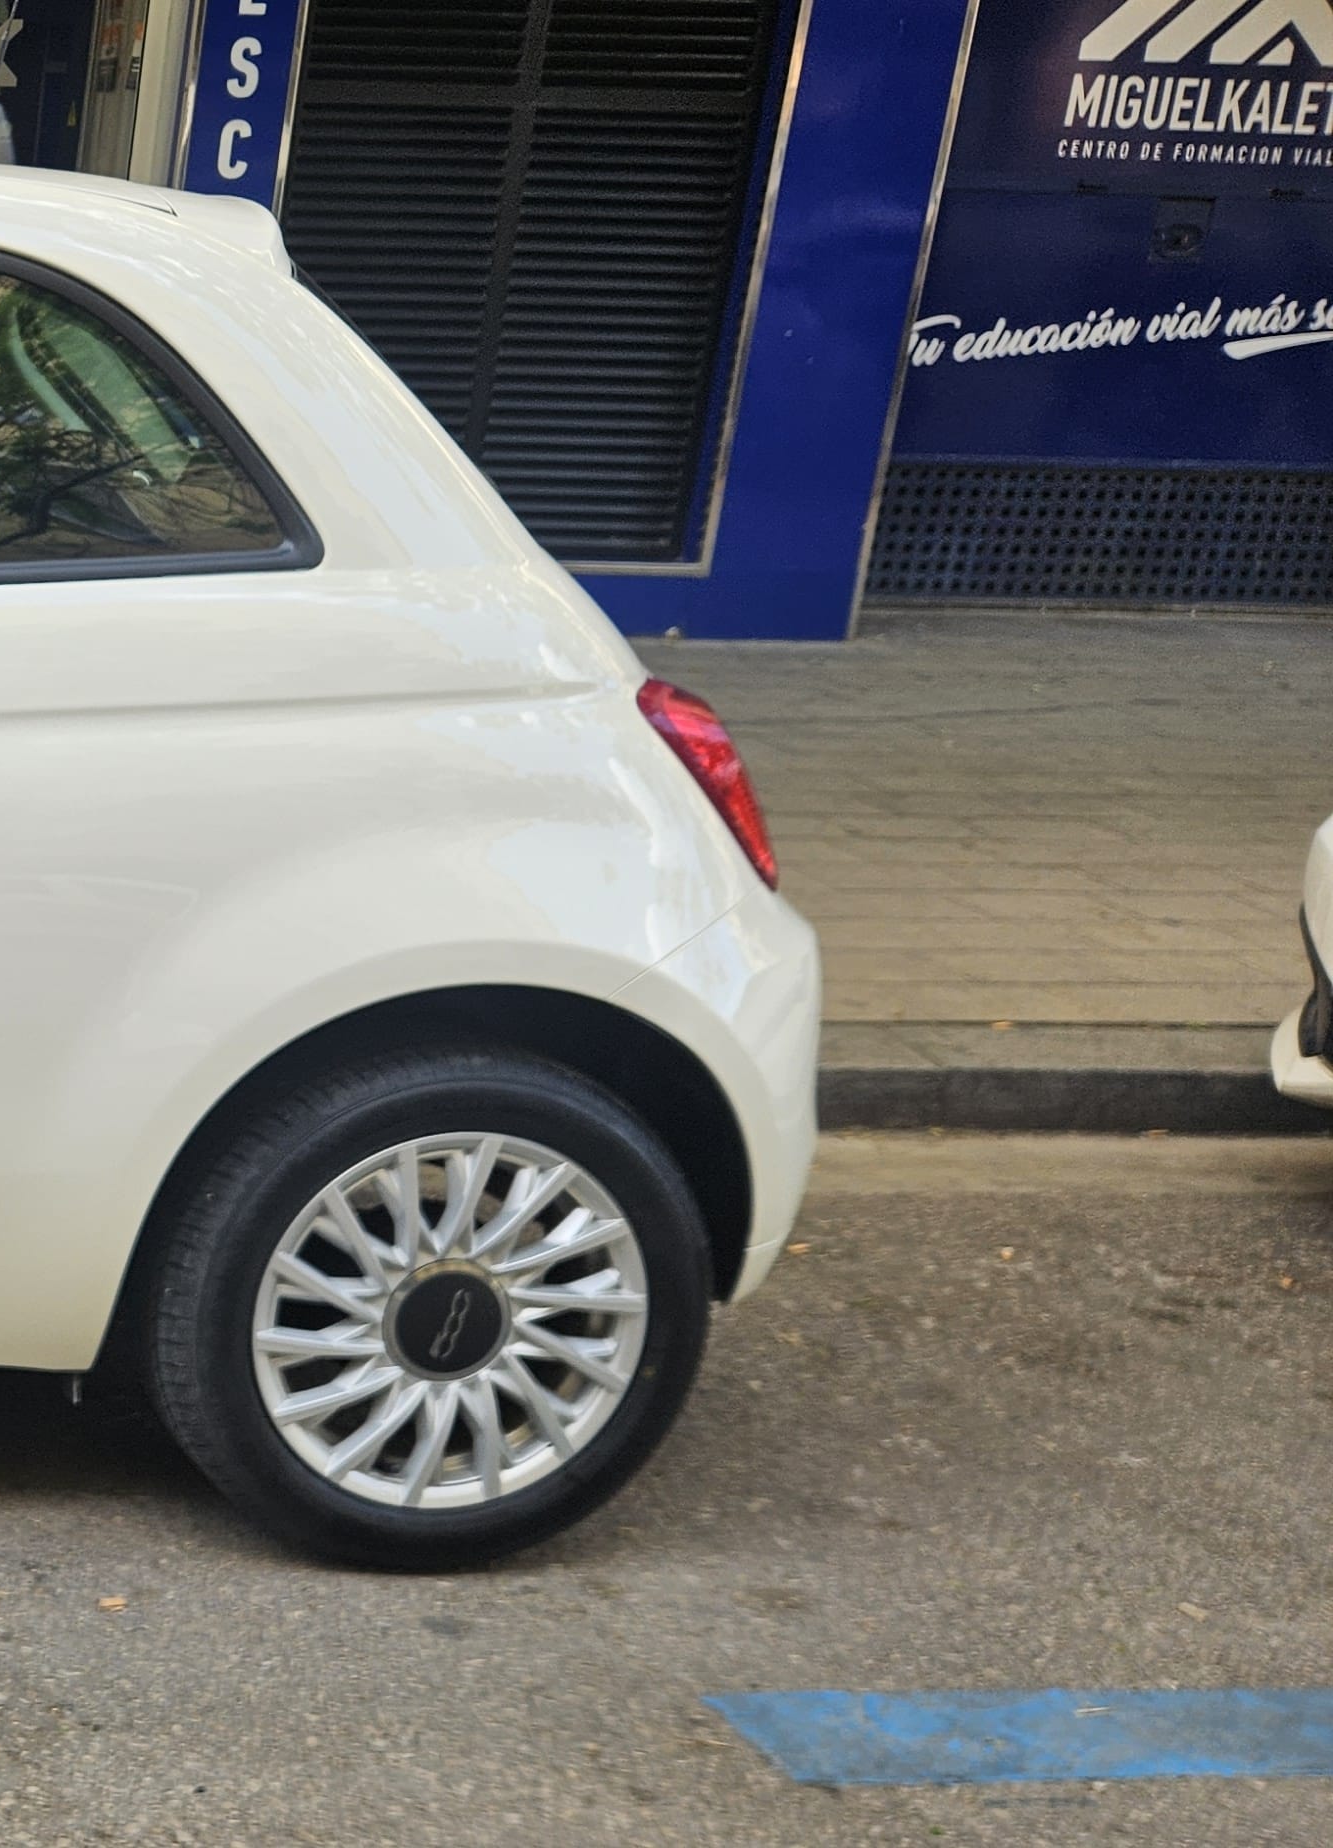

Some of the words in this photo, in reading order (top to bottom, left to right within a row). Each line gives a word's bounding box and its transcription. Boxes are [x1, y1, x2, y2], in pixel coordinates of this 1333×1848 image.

[1057, 139, 1130, 161] CENTRO
[1140, 142, 1164, 162] DE
[1173, 143, 1283, 165] FORMACION
[953, 307, 1142, 363] educación
[1146, 296, 1222, 343] vial
[1225, 293, 1306, 337] más
